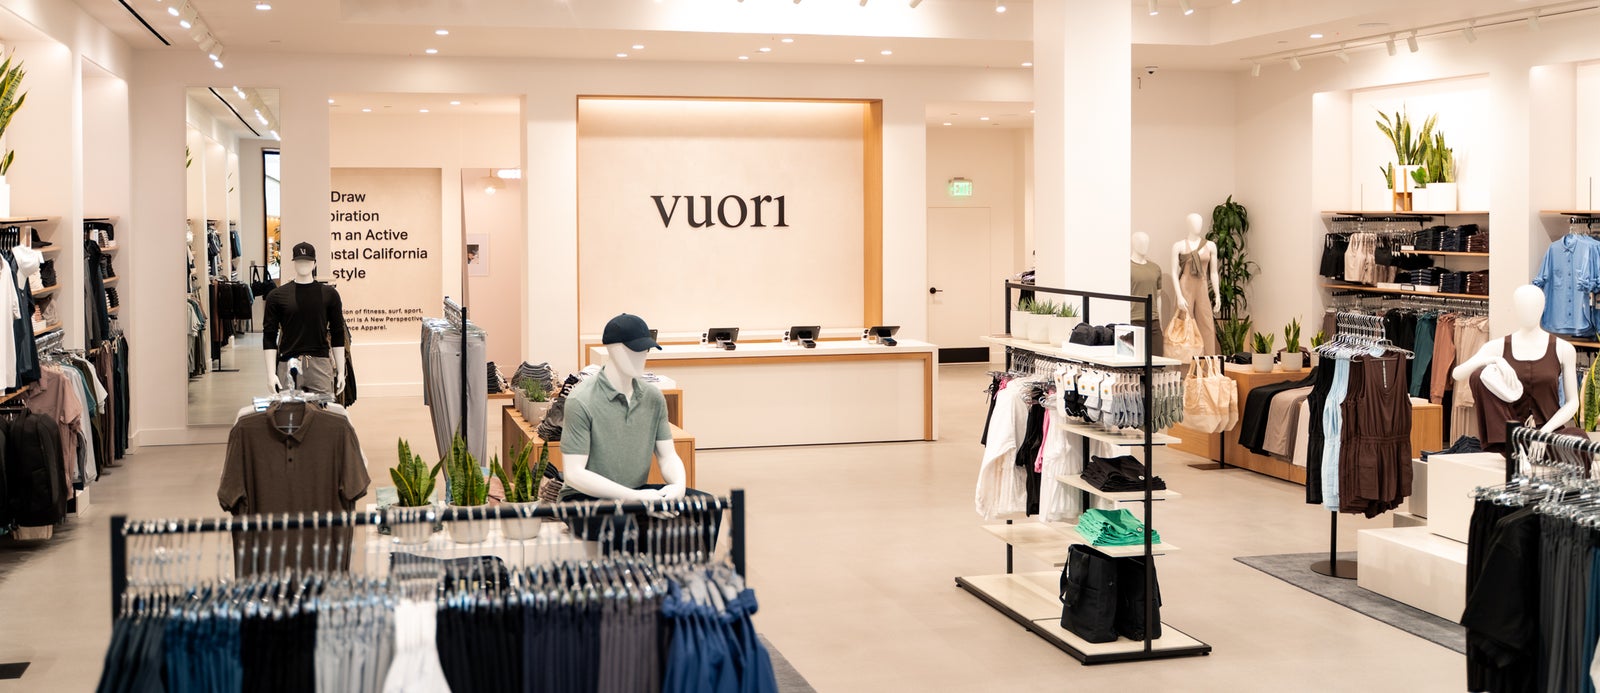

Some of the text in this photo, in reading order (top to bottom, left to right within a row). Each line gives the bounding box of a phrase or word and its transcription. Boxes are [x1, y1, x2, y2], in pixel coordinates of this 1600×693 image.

[330, 191, 366, 202] Draw
[331, 210, 380, 222] iration
[650, 195, 789, 228] vuori
[345, 231, 362, 240] an
[366, 229, 408, 240] Active
[331, 248, 428, 260] stal California
[332, 267, 366, 281] style
